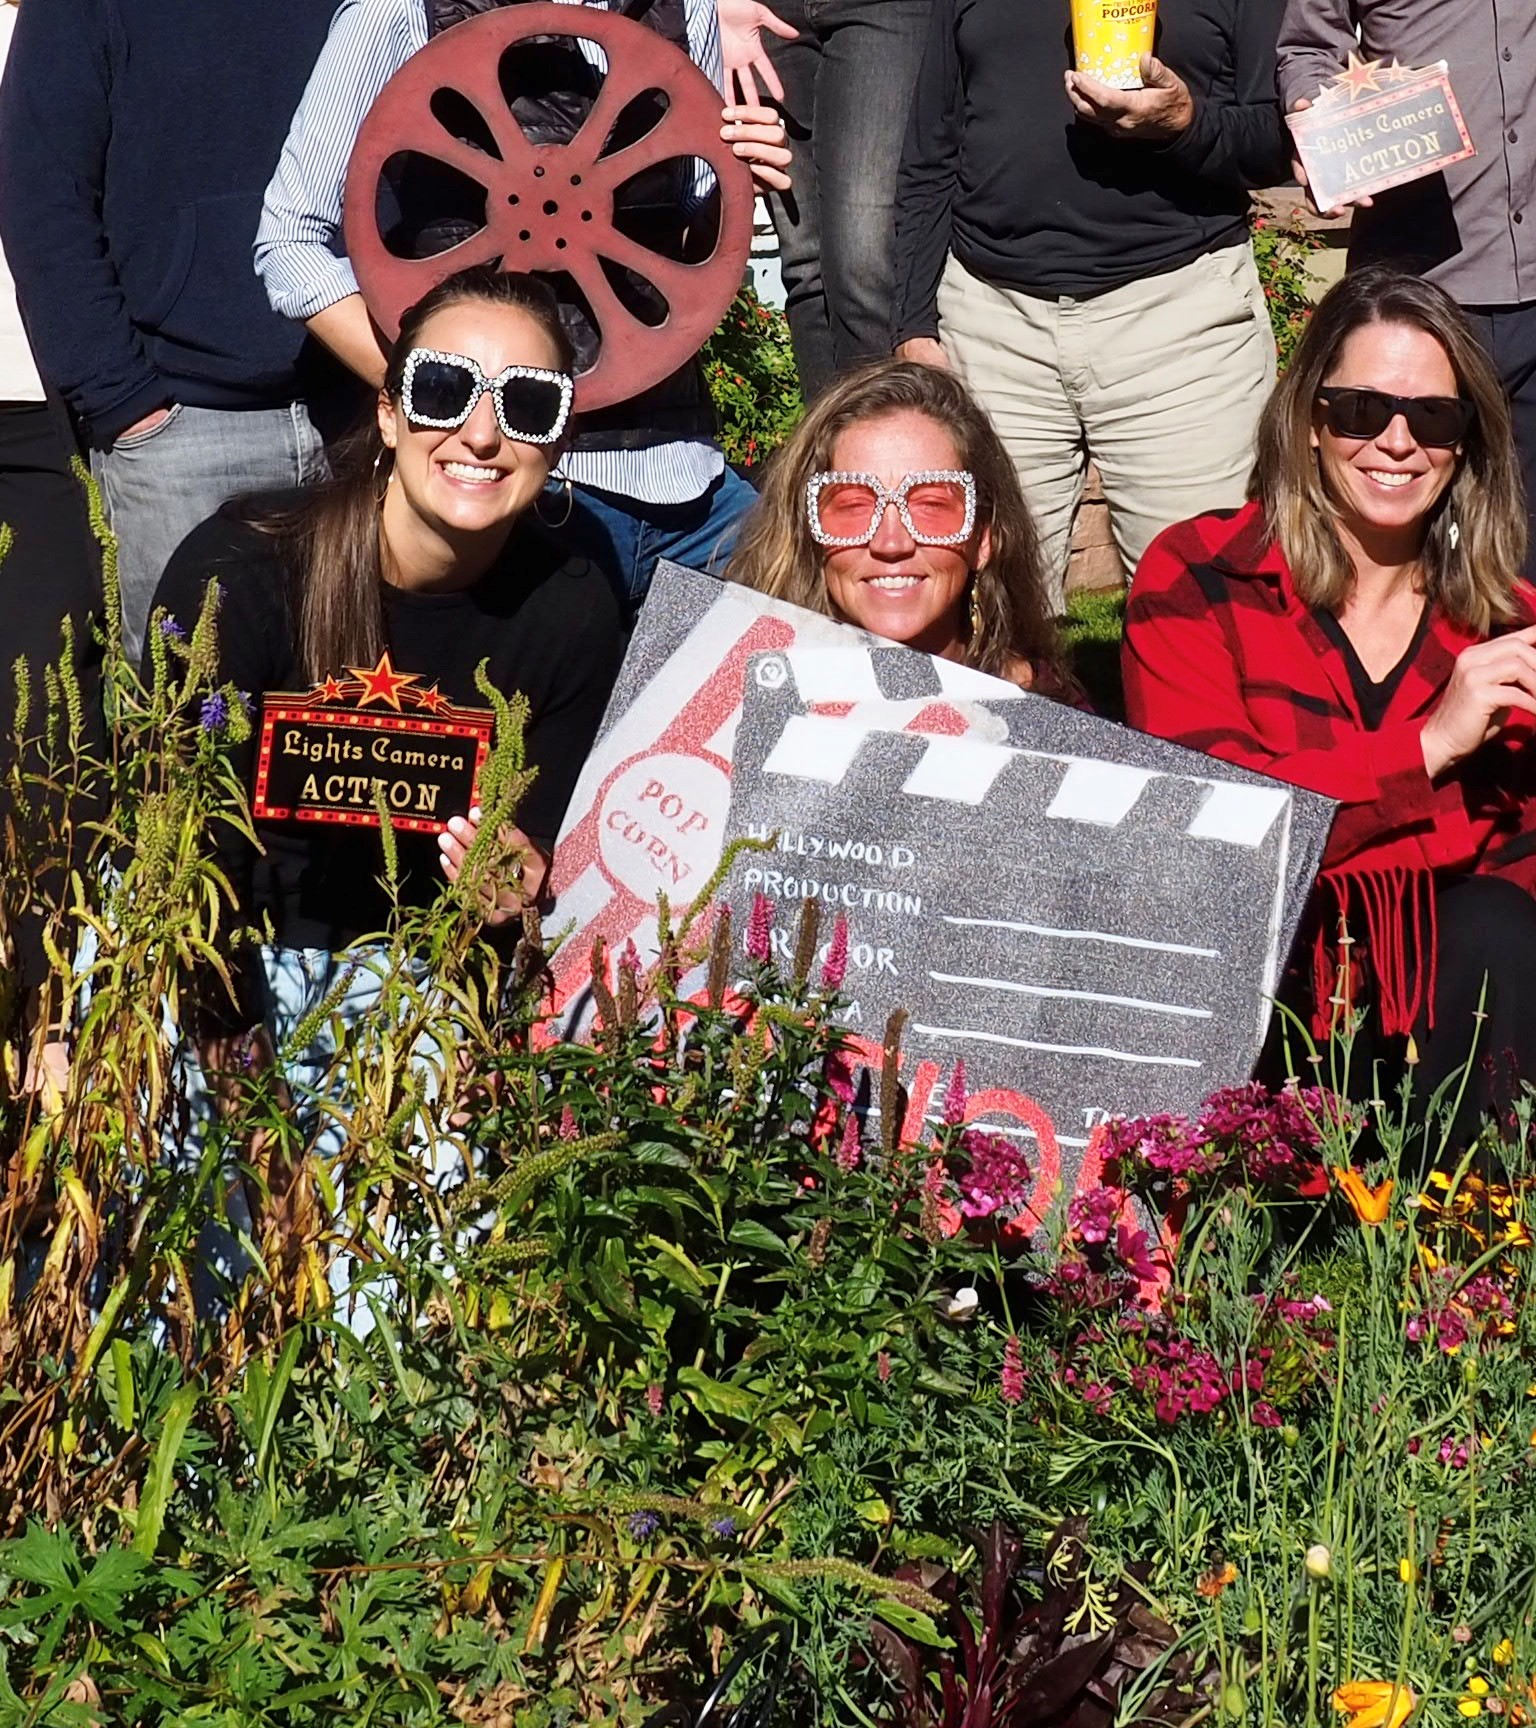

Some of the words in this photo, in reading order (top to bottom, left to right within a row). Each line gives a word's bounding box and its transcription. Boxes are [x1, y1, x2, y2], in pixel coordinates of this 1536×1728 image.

[1316, 127, 1375, 156] Lights
[1376, 103, 1445, 134] Camera
[1344, 131, 1441, 184] ACTION
[282, 730, 363, 764] Lights
[371, 737, 464, 771] Camera
[638, 778, 708, 834] POP
[606, 809, 693, 885] CORN
[748, 823, 915, 867] HLLYWOOD
[744, 868, 921, 916] PRODUCTION
